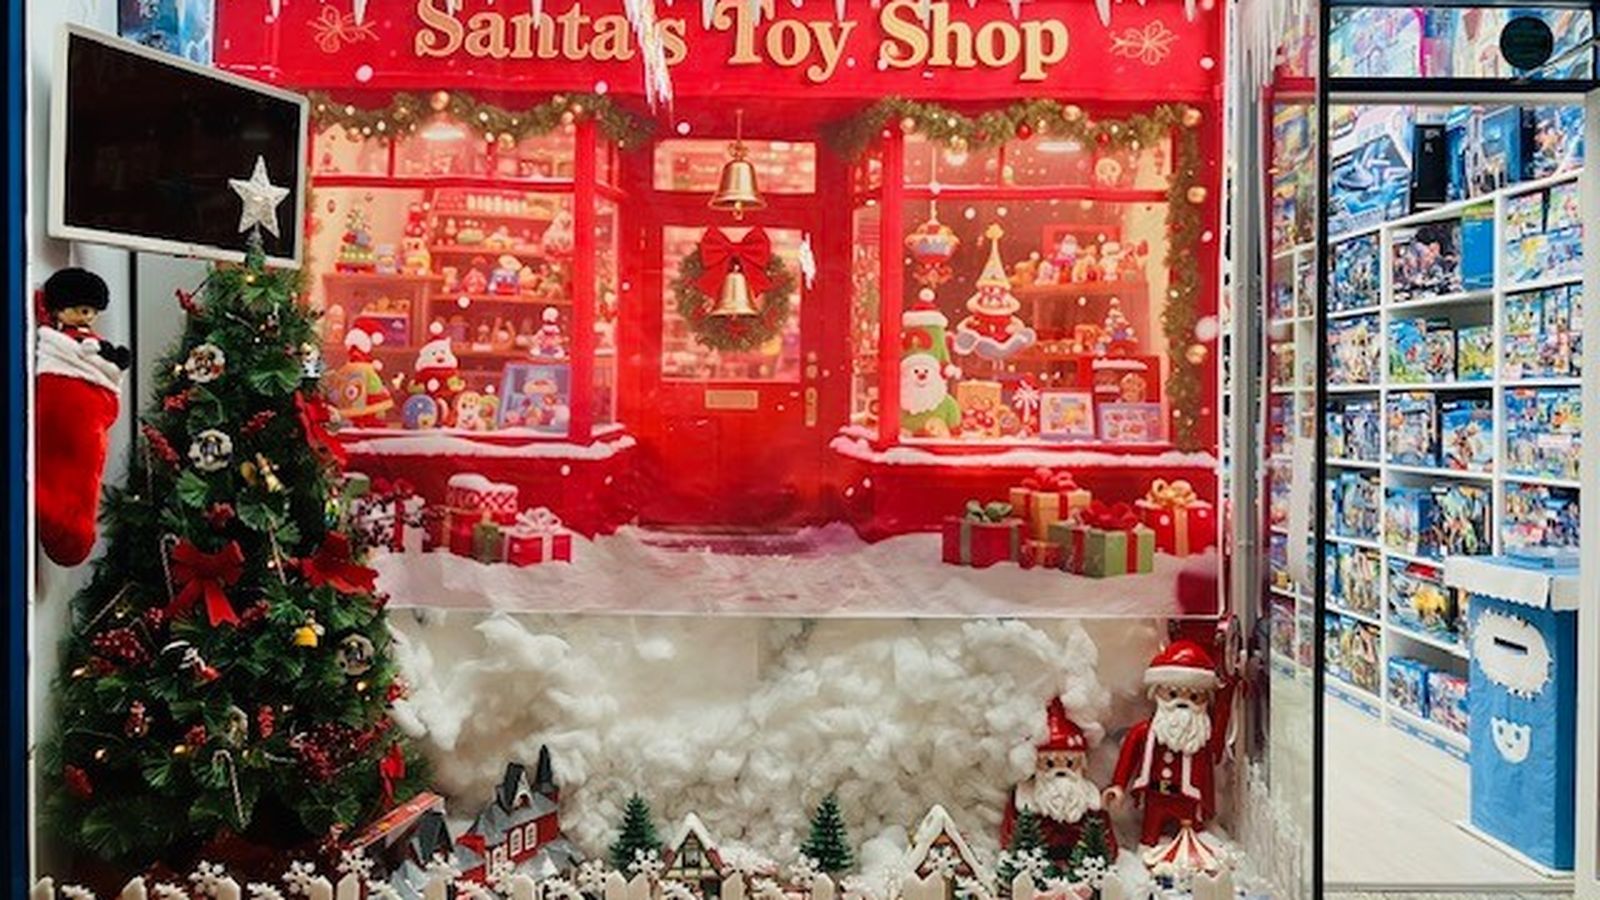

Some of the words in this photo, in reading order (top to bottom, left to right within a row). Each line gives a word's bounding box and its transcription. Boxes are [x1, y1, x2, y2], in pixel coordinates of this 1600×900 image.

[415, 0, 687, 65] Santas
[714, 0, 857, 82] Toy
[880, 0, 1069, 80] Shop
